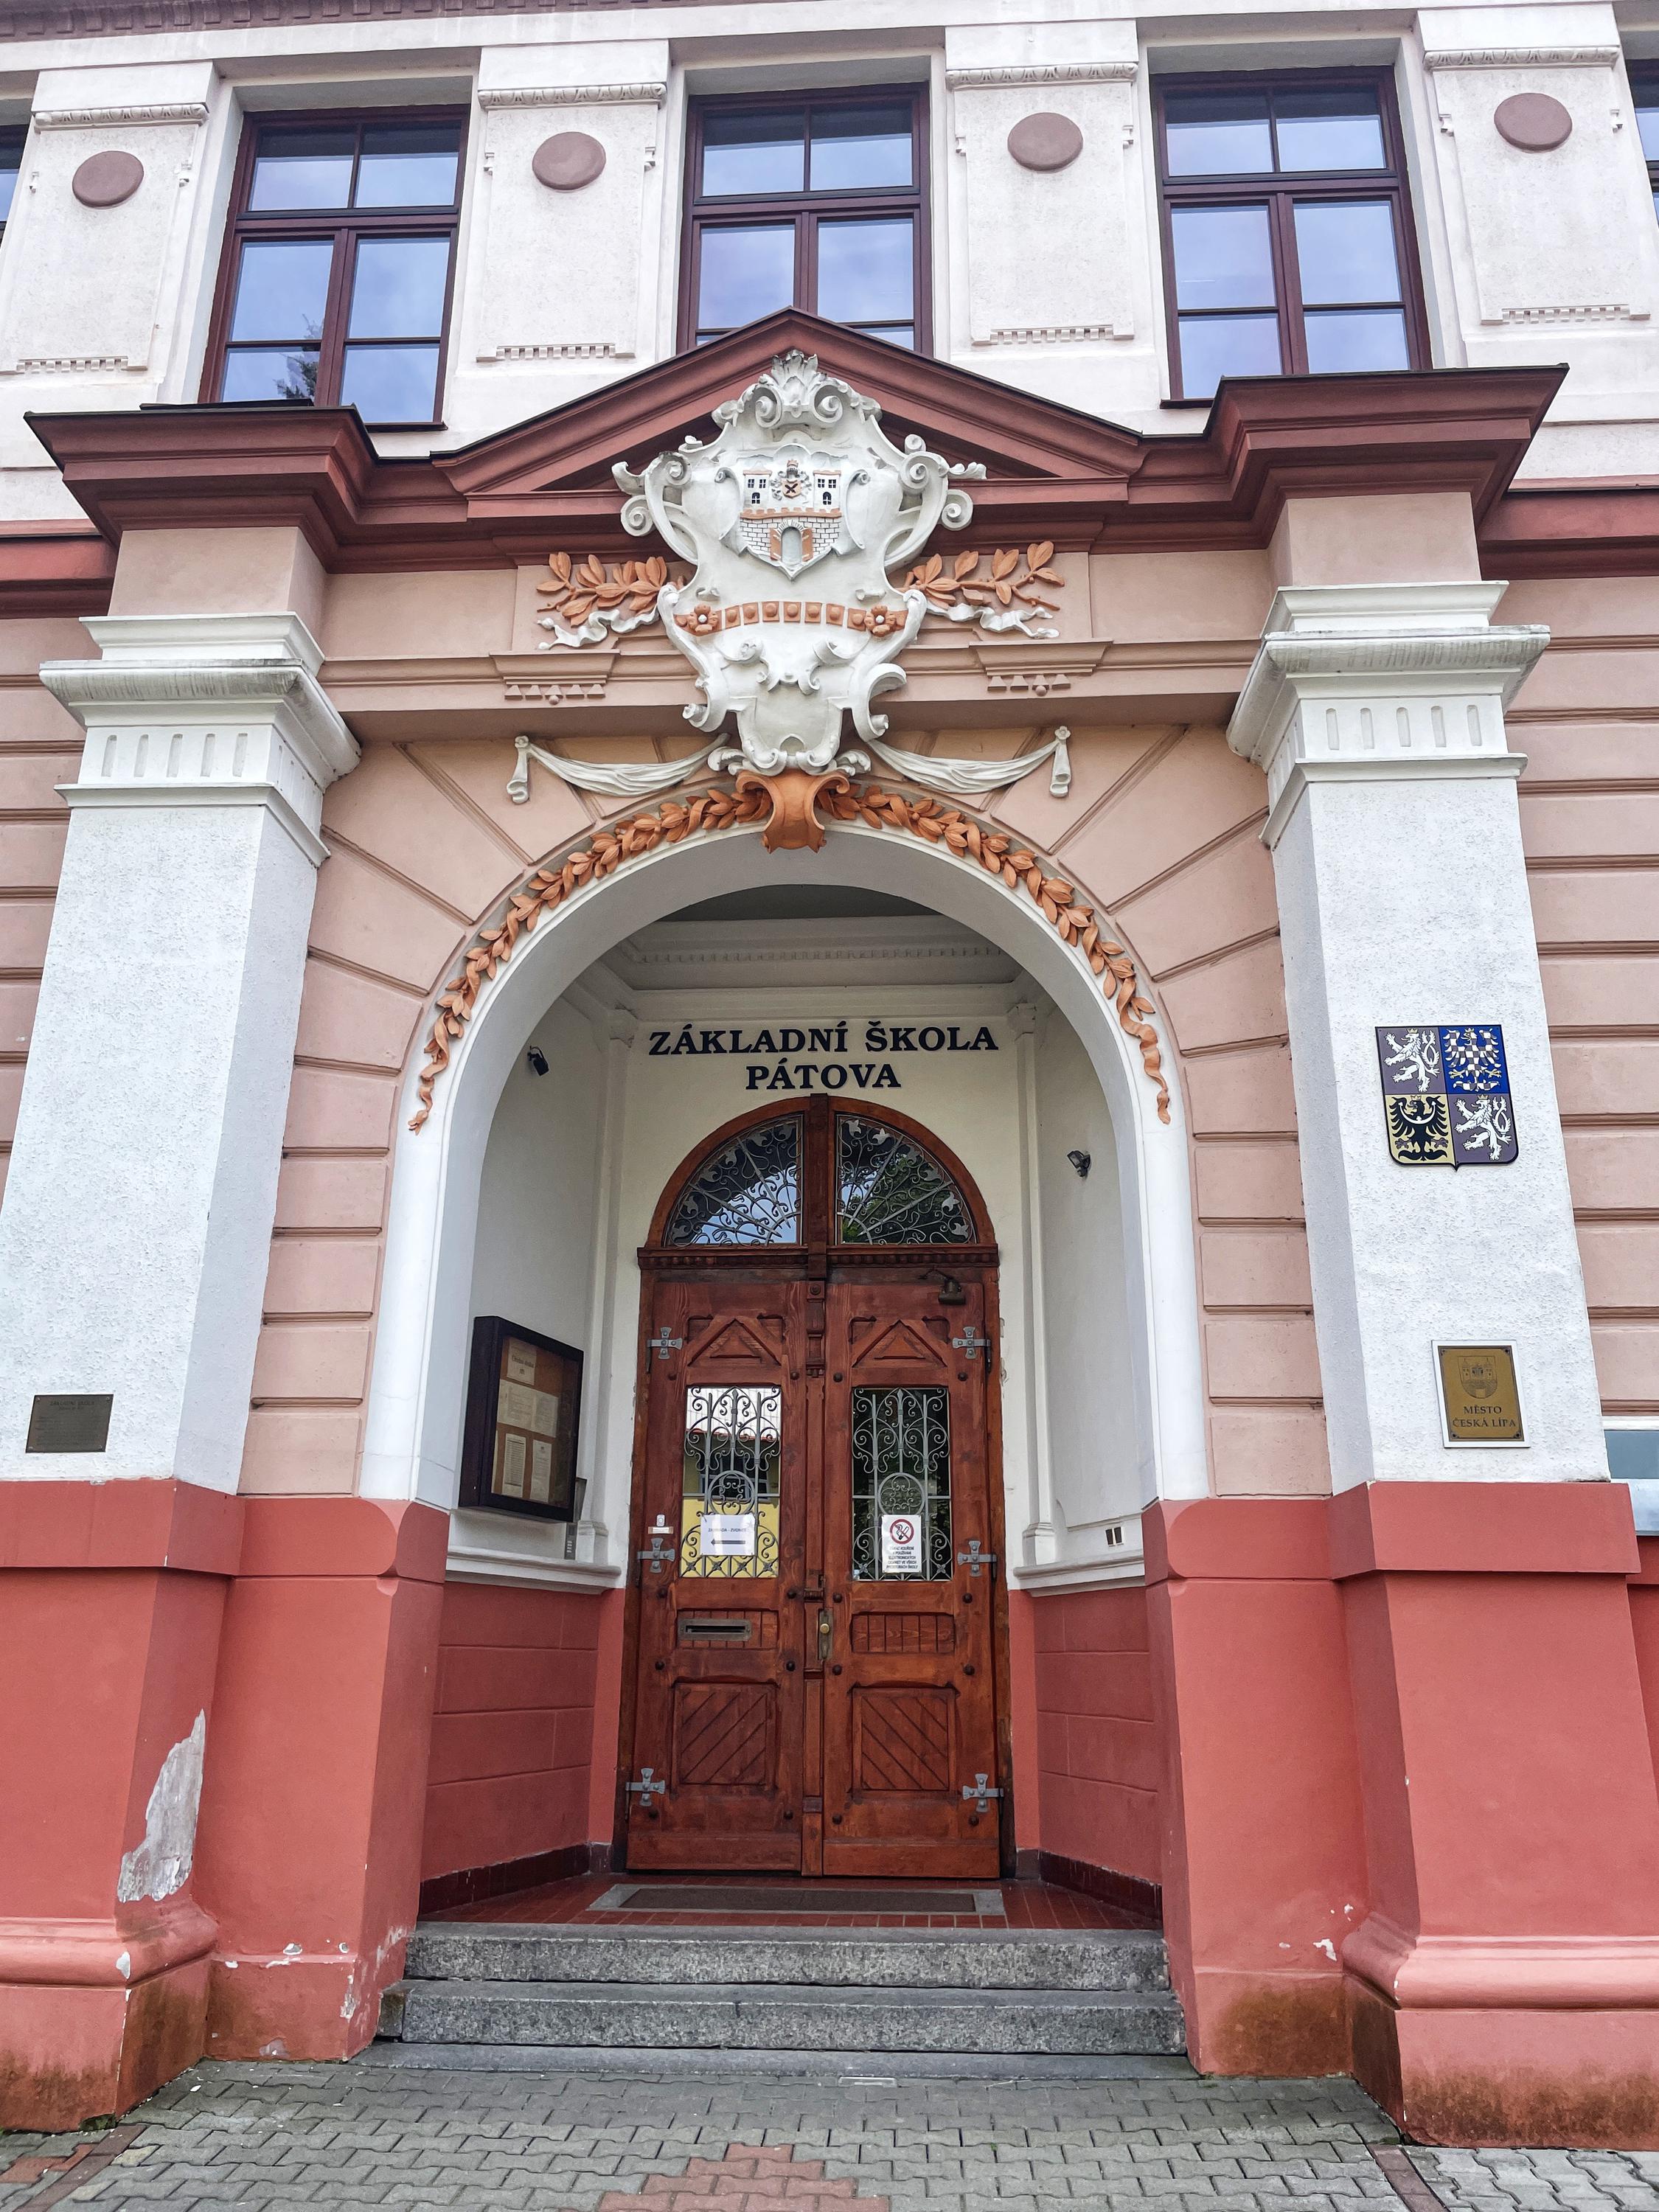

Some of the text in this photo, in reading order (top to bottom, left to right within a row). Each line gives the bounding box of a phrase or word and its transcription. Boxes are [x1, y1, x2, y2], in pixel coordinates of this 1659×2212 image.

[649, 1020, 998, 1055] ZÁKLADNÍ ŠKOLA
[745, 1057, 901, 1090] PÁTOVA
[1464, 1405, 1502, 1414] MĚSTO
[1453, 1417, 1516, 1427] ČESKÁ LÍPA
